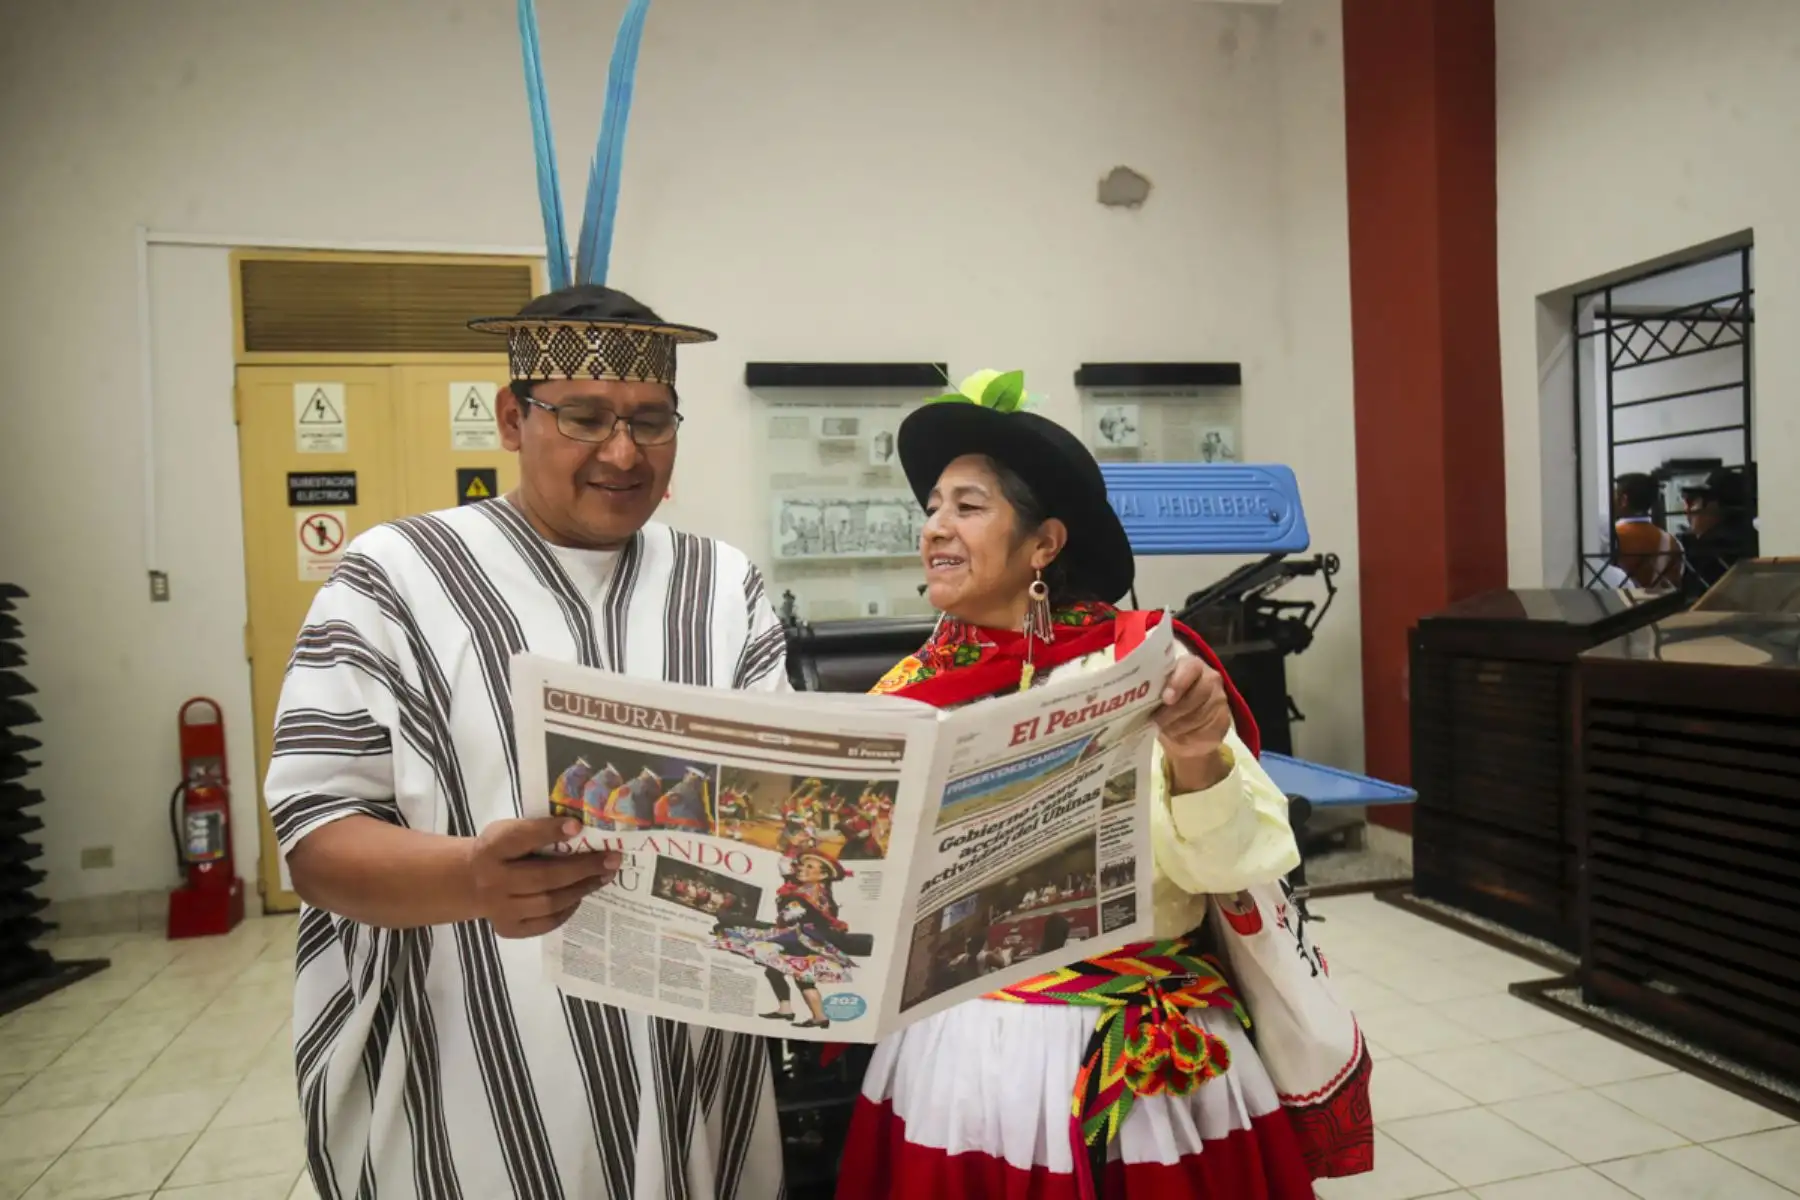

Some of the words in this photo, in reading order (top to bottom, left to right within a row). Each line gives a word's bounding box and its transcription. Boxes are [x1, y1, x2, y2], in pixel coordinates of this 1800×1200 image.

[1155, 494, 1270, 519] HEIDELBERG
[547, 690, 685, 735] CULTURAL
[1008, 716, 1041, 748] El
[1043, 680, 1151, 736] Peruano
[920, 836, 1009, 894] actividad
[1010, 818, 1039, 843] del
[1041, 788, 1101, 824] Ubinas
[939, 807, 1030, 853] Gobierno
[1032, 764, 1105, 812] coordina
[959, 812, 1038, 860] acciones
[1038, 788, 1079, 817] ante
